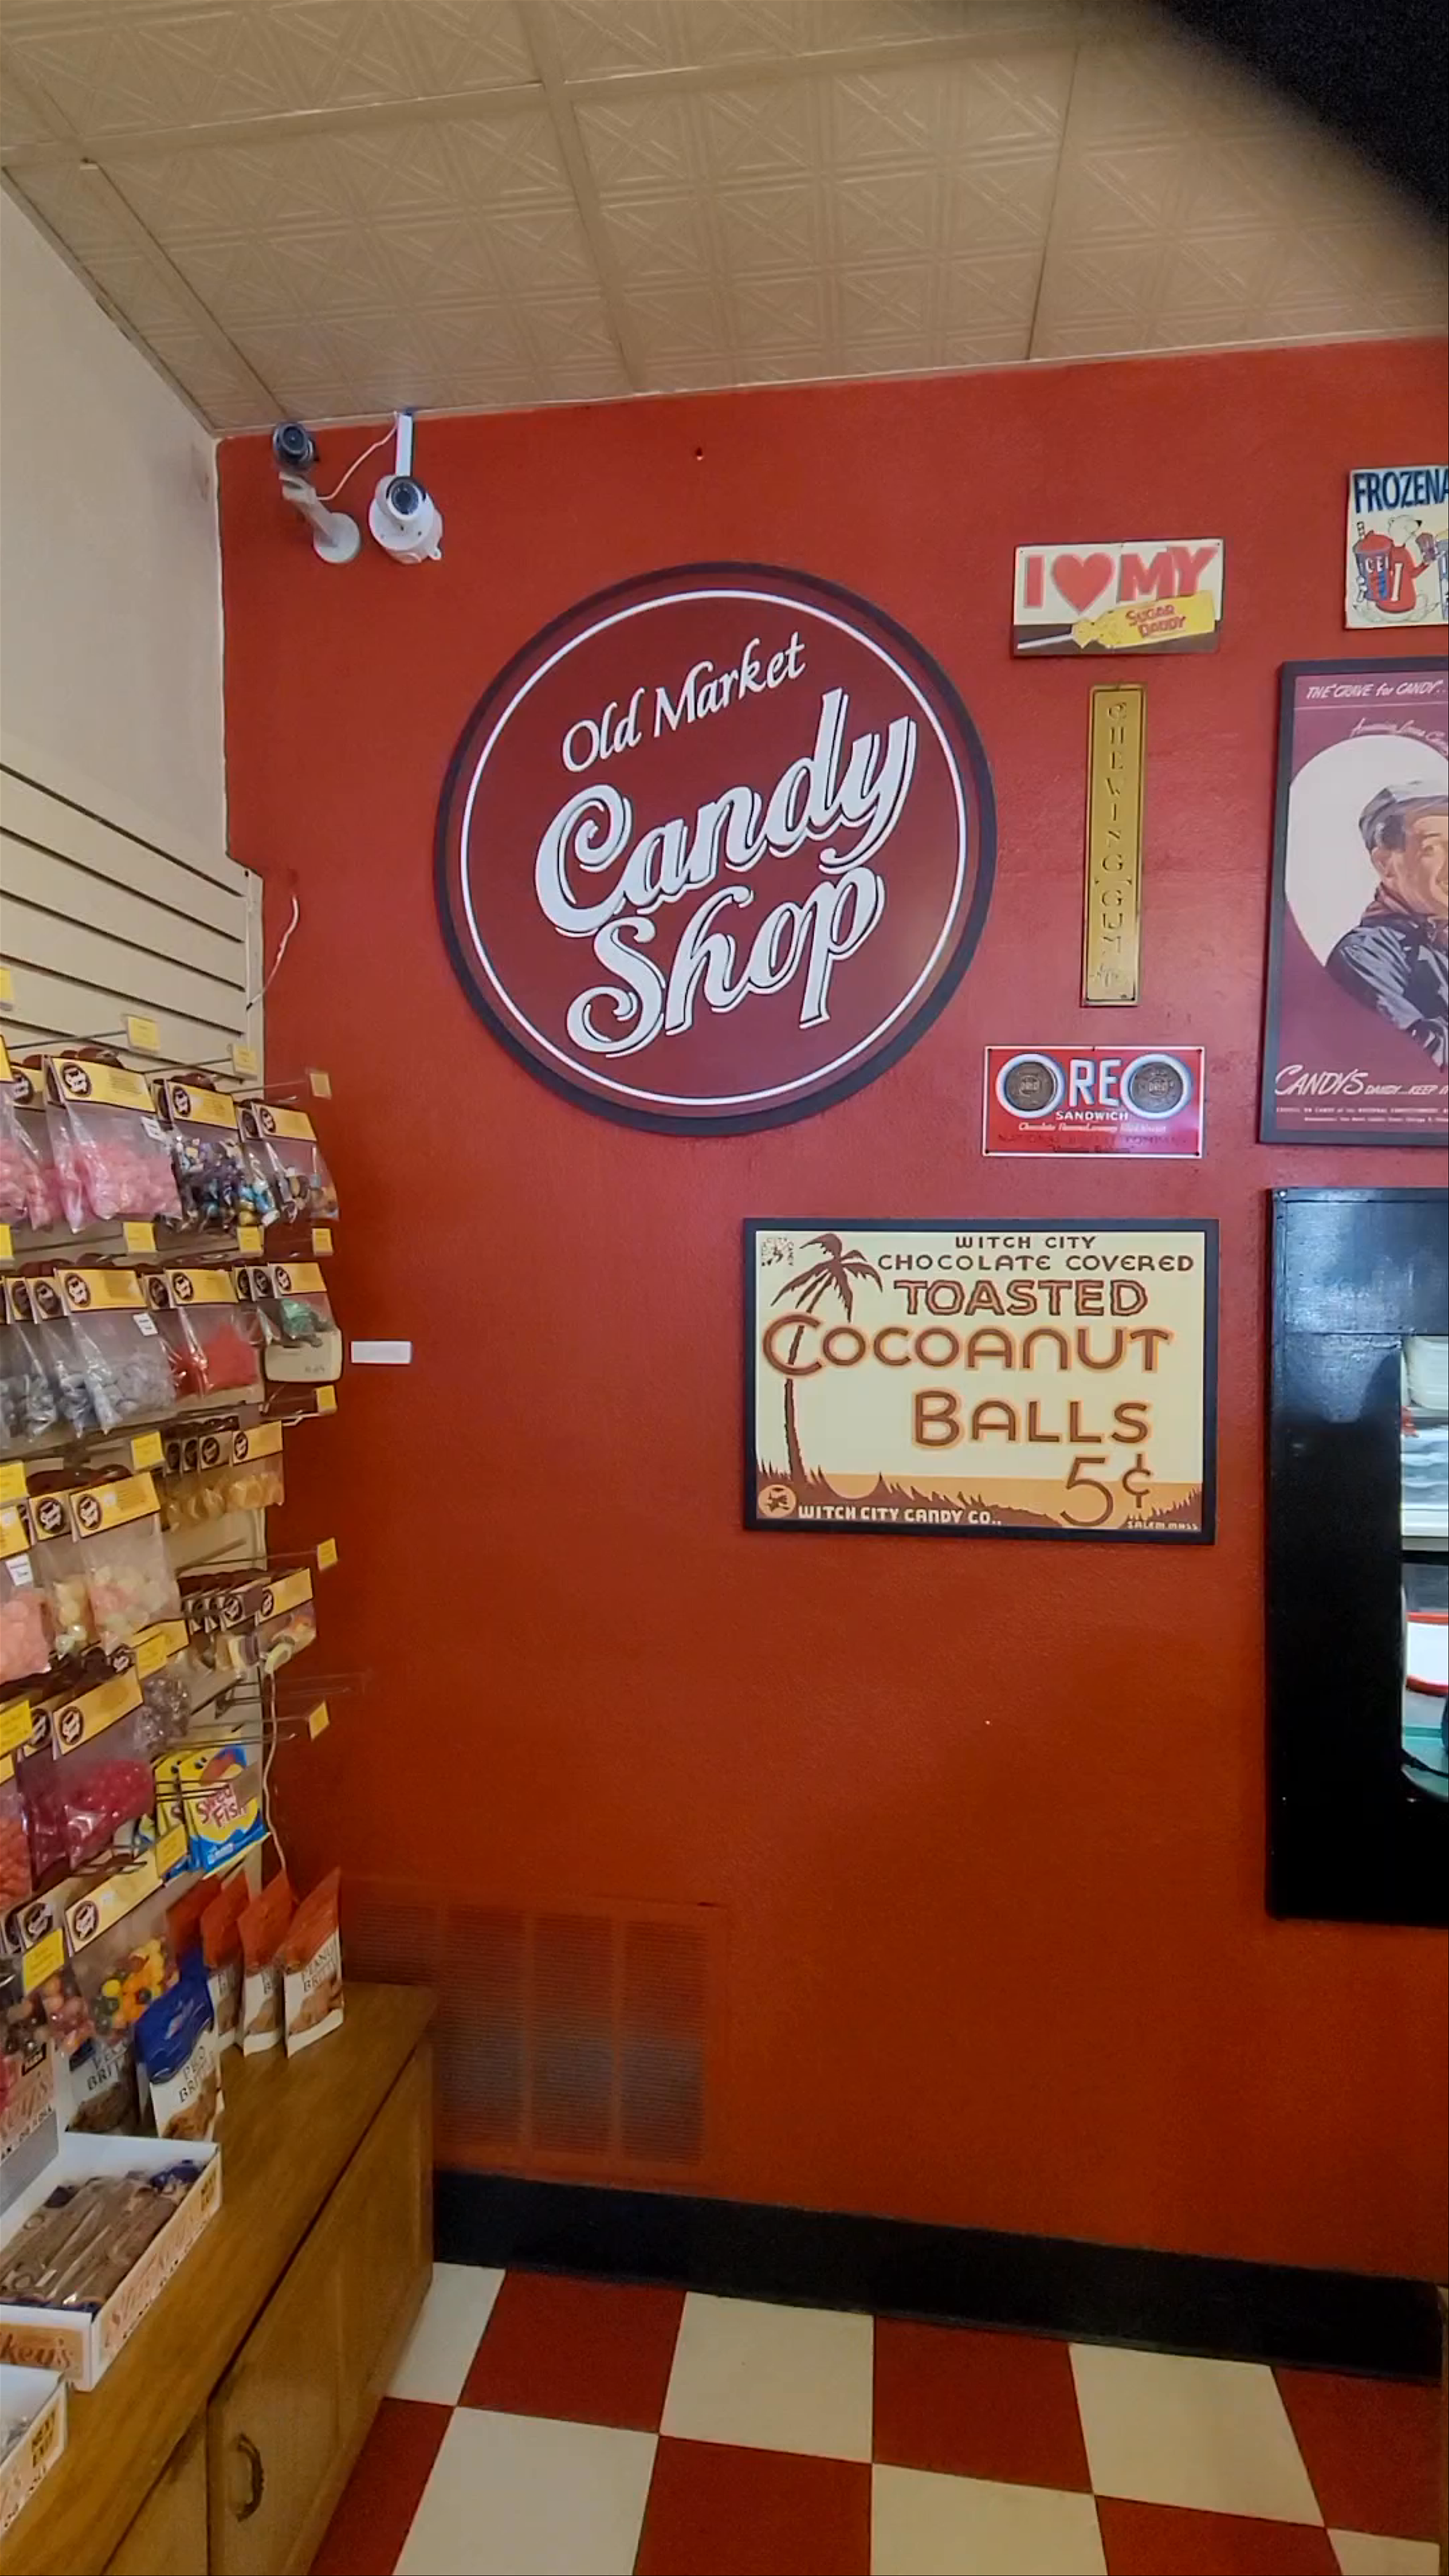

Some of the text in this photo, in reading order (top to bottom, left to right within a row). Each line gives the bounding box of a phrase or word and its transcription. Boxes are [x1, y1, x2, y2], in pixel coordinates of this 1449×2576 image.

[1024, 546, 1218, 608] I MY
[562, 632, 806, 772] Old Market
[1306, 684, 1334, 700] THE
[1375, 682, 1394, 697] for
[534, 687, 917, 938] Candy
[566, 866, 885, 1058] Shop
[996, 1053, 1191, 1120] OREO
[1055, 1110, 1129, 1121] SANDWICH
[877, 1254, 1194, 1272] CHOCOLATE COVERED
[955, 1235, 1097, 1249] WITCH CITY
[893, 1280, 1149, 1316] TOASTED
[762, 1313, 1172, 1376] COCOANUT
[914, 1390, 1150, 1447] BALLS
[798, 1506, 856, 1520] WITCH
[860, 1507, 899, 1521] CITY
[904, 1509, 964, 1523] CANDY
